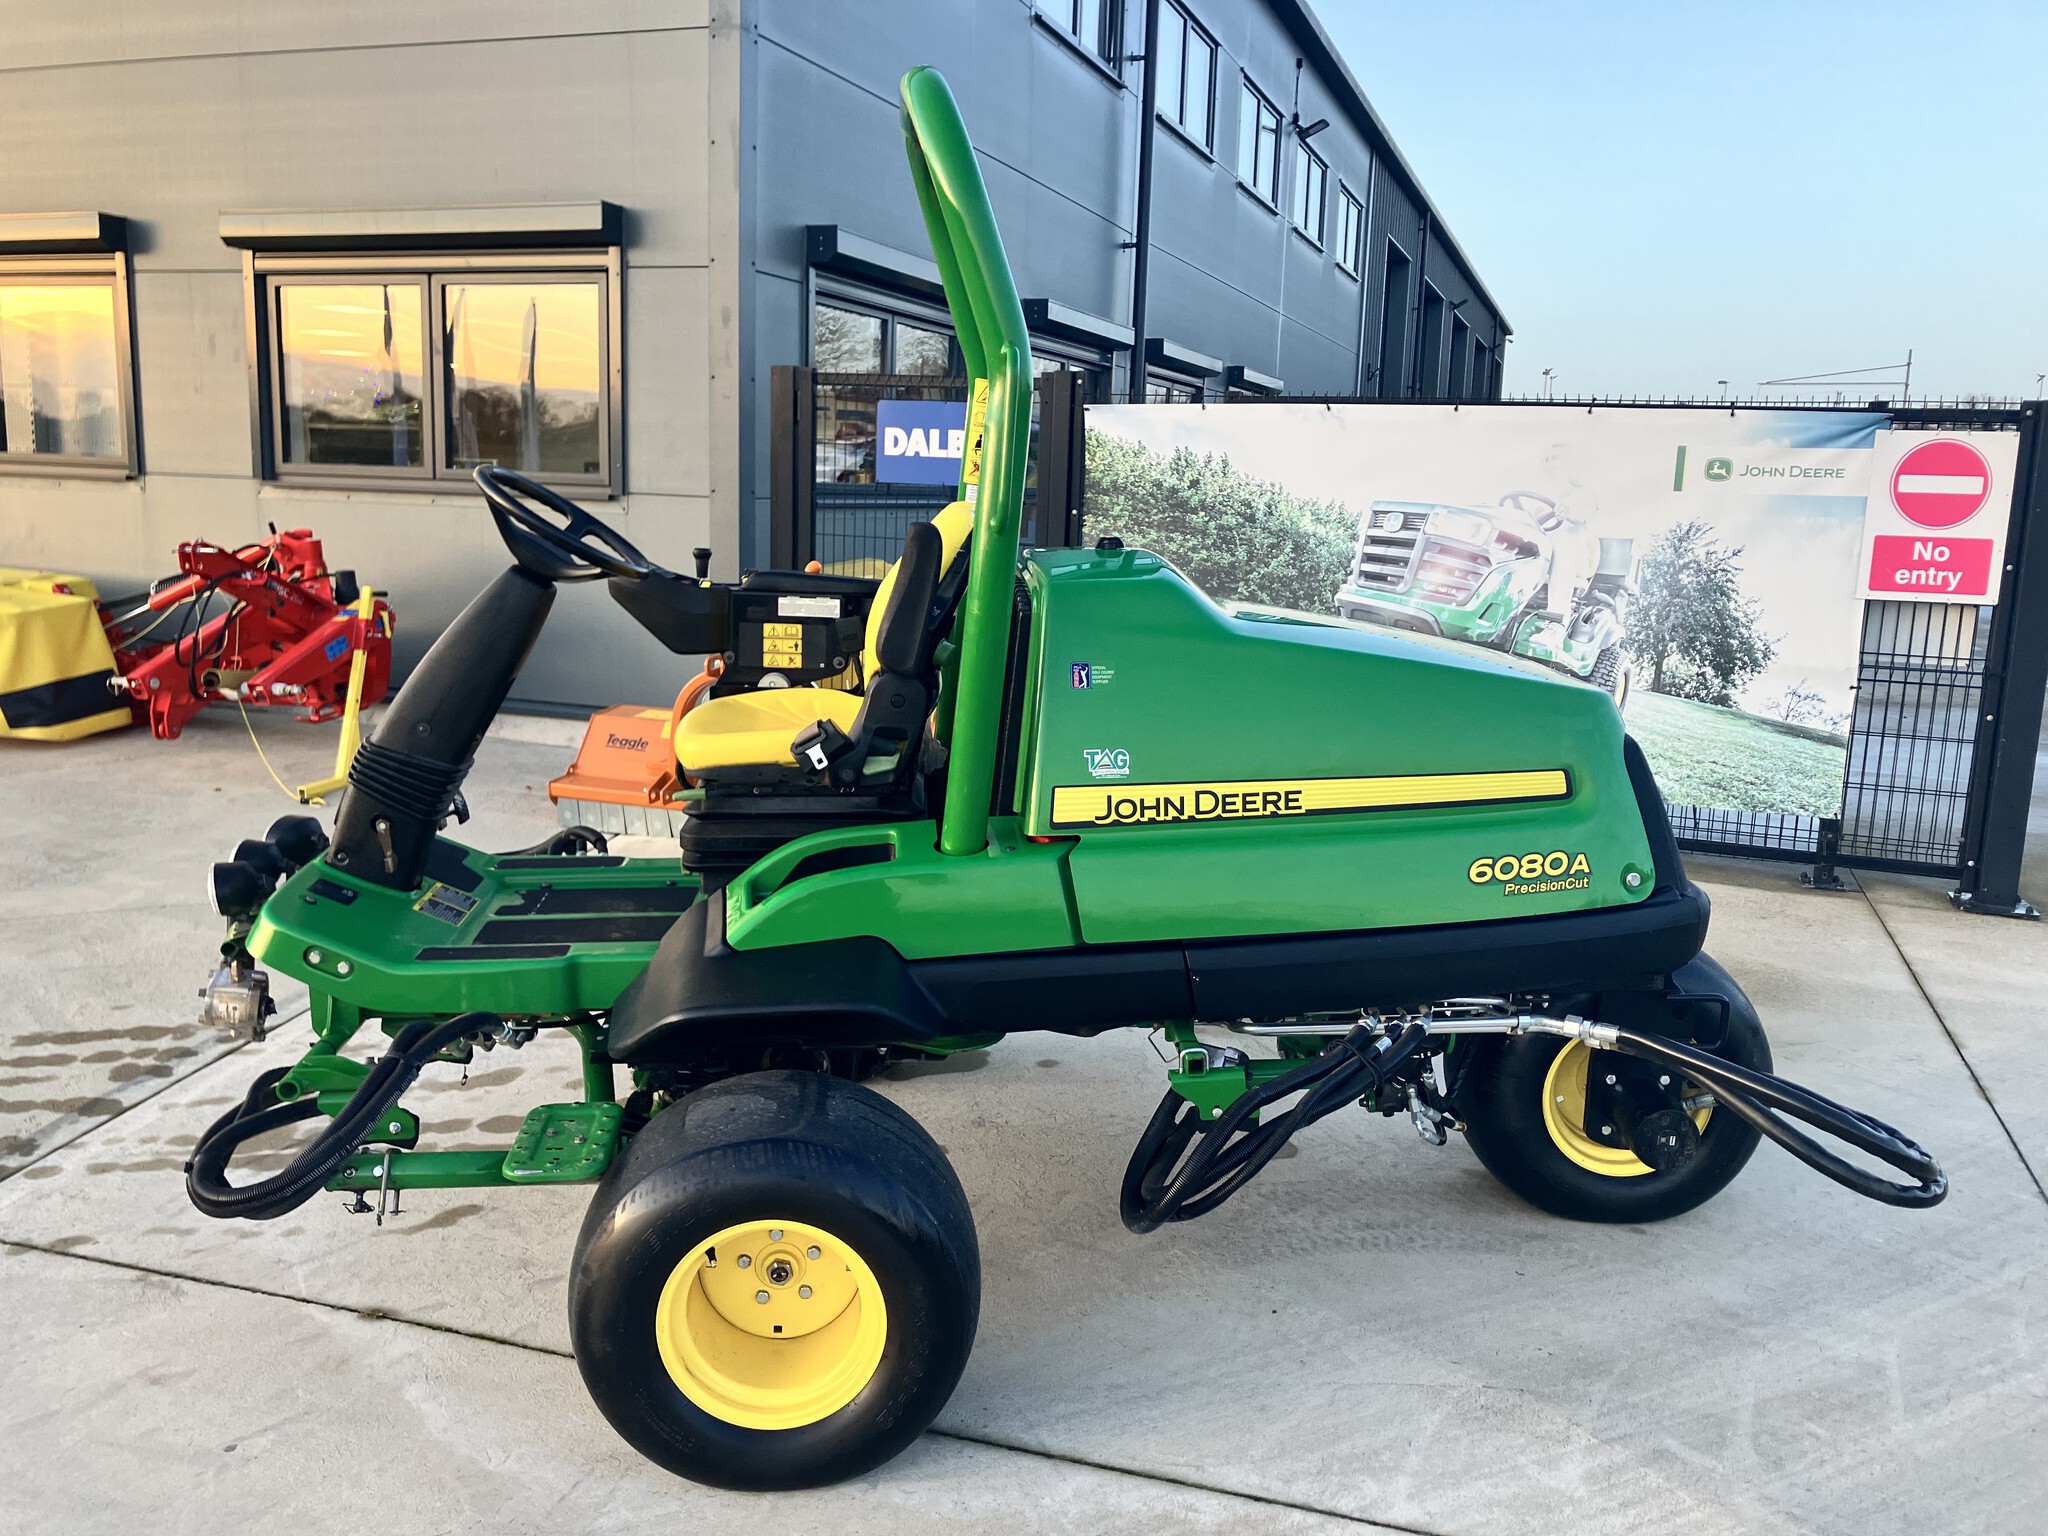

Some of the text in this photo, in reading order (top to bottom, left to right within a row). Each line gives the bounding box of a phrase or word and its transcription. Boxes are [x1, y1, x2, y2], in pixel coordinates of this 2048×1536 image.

[1739, 463, 1846, 479] JOHN DEERE
[1912, 541, 1951, 562] No
[1894, 568, 1963, 591] entry
[606, 733, 649, 750] Teagle
[1083, 748, 1130, 771] TAG
[1094, 789, 1303, 822] JOHN DEERE
[1468, 850, 1592, 885] 6080A
[1503, 876, 1589, 896] PrecisionCut
